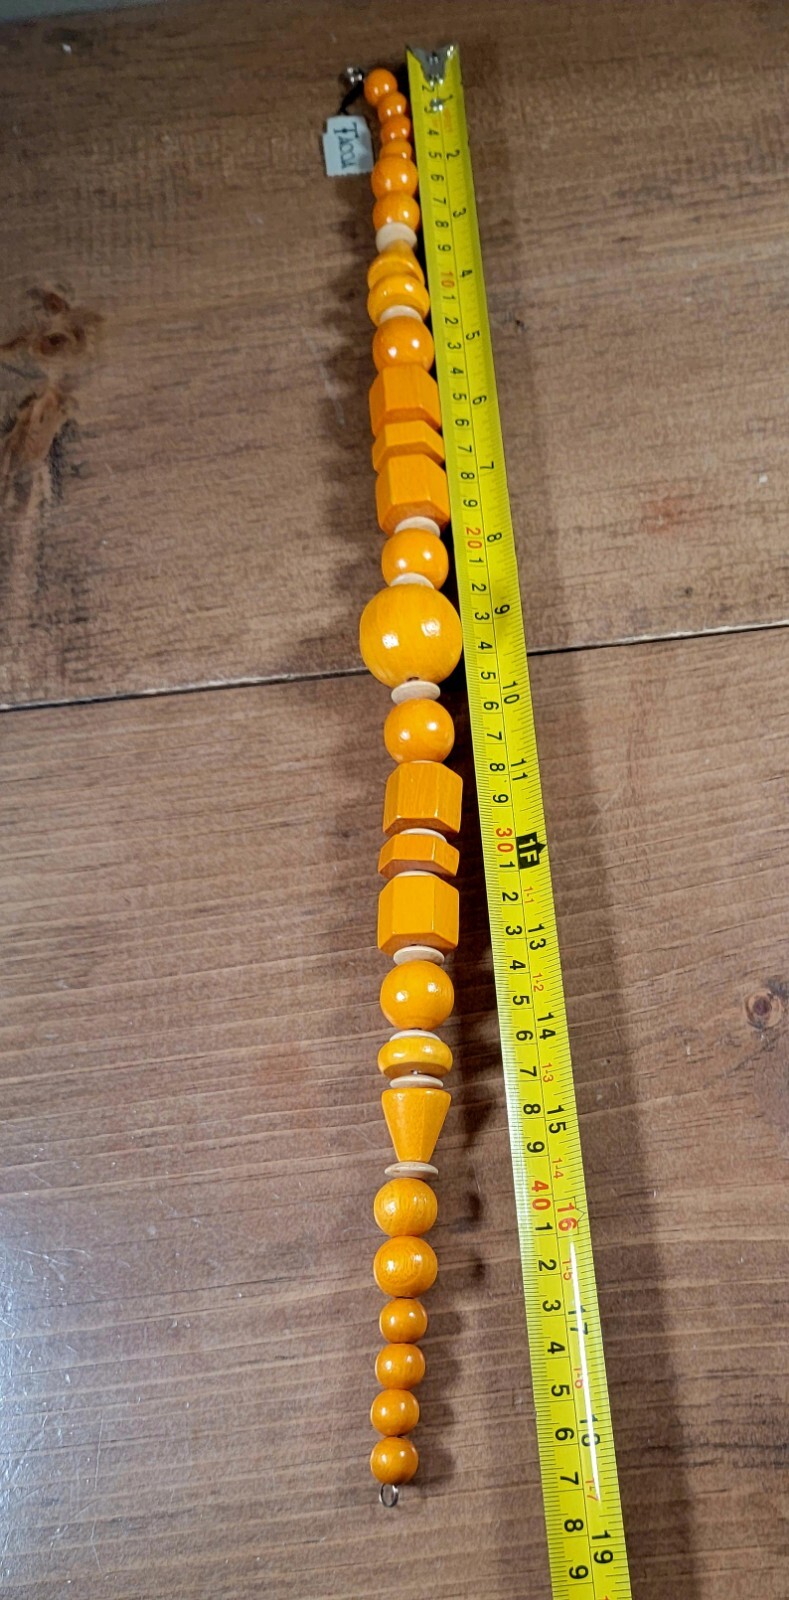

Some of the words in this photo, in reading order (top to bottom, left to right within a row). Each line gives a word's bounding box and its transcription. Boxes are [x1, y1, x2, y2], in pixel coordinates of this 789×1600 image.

[446, 149, 460, 160] 2
[431, 174, 444, 182] 6
[433, 197, 447, 205] 7
[452, 208, 466, 218] 3
[435, 220, 449, 228] 8
[438, 244, 451, 252] 9
[459, 269, 473, 278] 4
[440, 271, 455, 289] 10
[444, 317, 459, 325] 2
[465, 330, 481, 341] 5
[447, 342, 462, 350] 3
[450, 367, 464, 375] 4
[452, 393, 467, 401] 5
[472, 394, 487, 406] 6
[455, 418, 469, 427] 6
[458, 445, 472, 453] 7
[479, 460, 495, 470] 7
[460, 471, 475, 480] 8
[463, 499, 478, 508] 9
[466, 527, 482, 550] 20
[486, 532, 502, 543] 8
[471, 584, 487, 592] 2
[494, 604, 510, 615] 9
[474, 612, 490, 621] 3
[478, 641, 493, 650] 4
[481, 671, 496, 680] 5
[502, 680, 520, 705] 10
[483, 701, 499, 711] 6
[487, 731, 502, 741] 7
[489, 762, 506, 772] 8
[511, 757, 528, 781] 11
[492, 794, 509, 804] 9
[496, 827, 514, 853] 30
[518, 838, 538, 864] 1F
[502, 891, 519, 902] 2
[505, 925, 522, 936] 3
[527, 923, 546, 950] 13
[509, 959, 526, 970] 4
[532, 972, 544, 992] 1-2
[512, 995, 530, 1006] 5
[537, 1011, 556, 1040] 14
[516, 1030, 533, 1041] 6
[520, 1066, 537, 1077] 7
[542, 1062, 554, 1083] 1-3
[523, 1103, 541, 1115] 8
[546, 1104, 567, 1134] 15
[526, 1141, 545, 1153] 9
[552, 1158, 564, 1179] 1-4
[531, 1179, 551, 1211] 40
[557, 1202, 577, 1231] 16
[535, 1222, 553, 1231] 1
[538, 1259, 557, 1272] 2
[542, 1299, 561, 1312] 3
[568, 1304, 588, 1336] 17
[547, 1341, 565, 1354] 4
[551, 1384, 570, 1397] 5
[555, 1427, 575, 1441] 6
[560, 1471, 579, 1485] 7
[564, 1518, 584, 1533] 8
[591, 1529, 614, 1564] 19
[569, 1564, 589, 1580] 9
